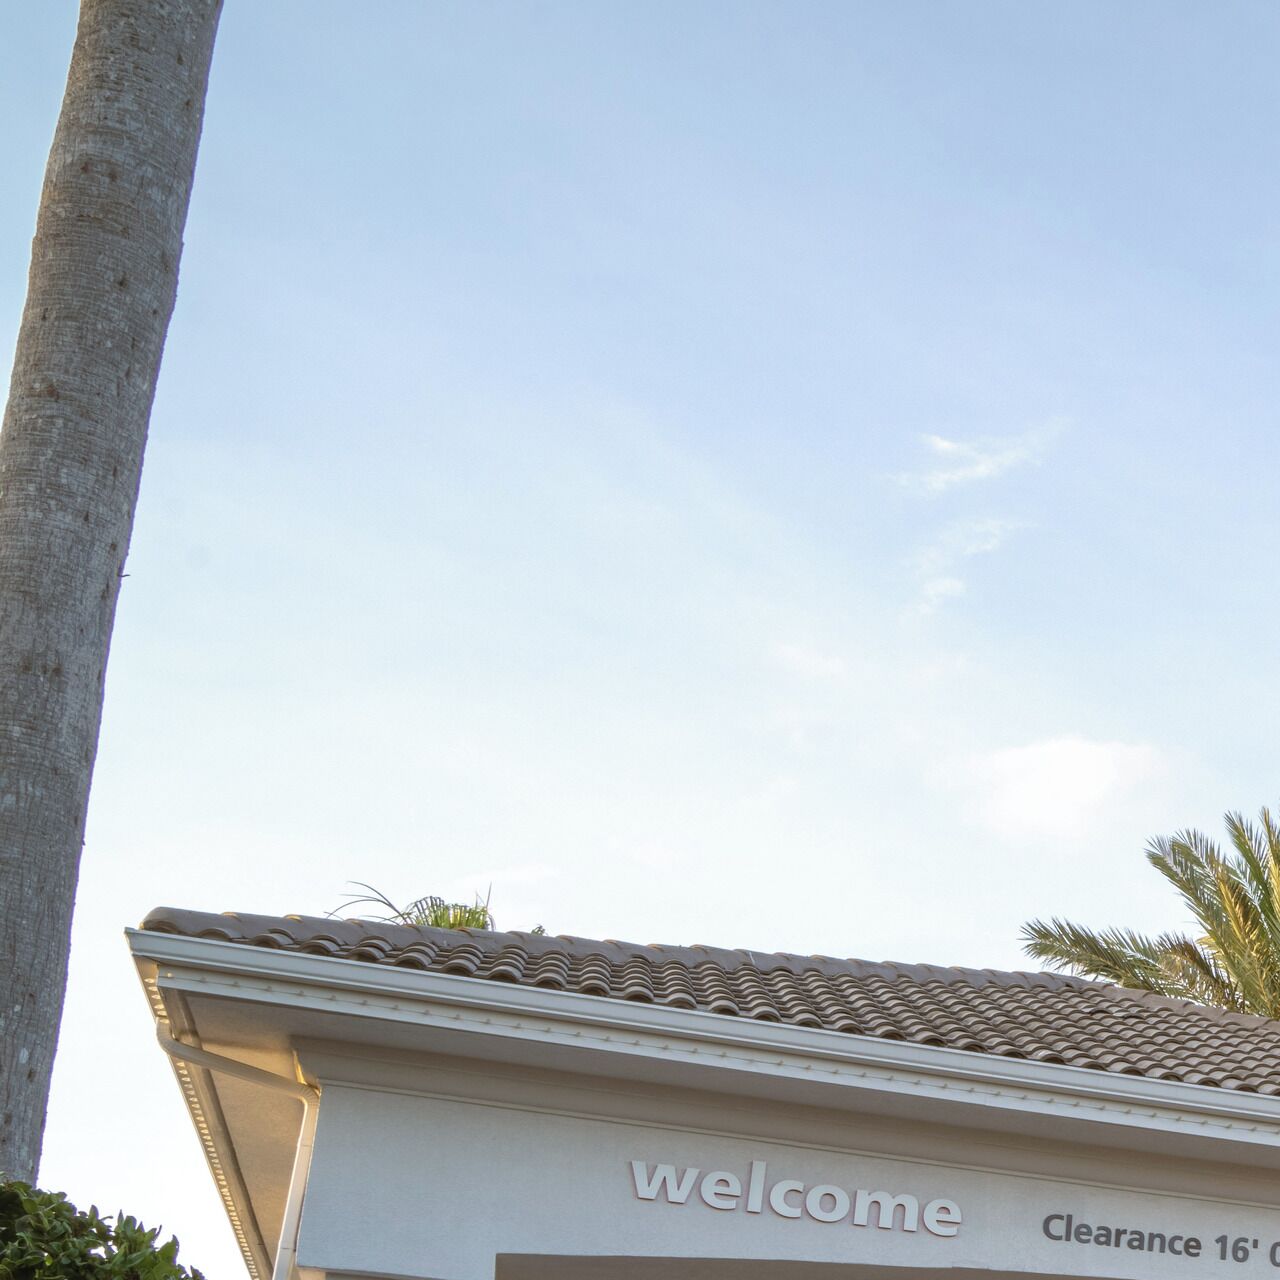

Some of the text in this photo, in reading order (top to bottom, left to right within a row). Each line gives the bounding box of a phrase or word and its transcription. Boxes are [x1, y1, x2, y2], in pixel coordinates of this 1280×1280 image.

[631, 1160, 963, 1237] welcome
[1042, 1214, 1202, 1257] Clearance
[1214, 1234, 1259, 1263] 16'
